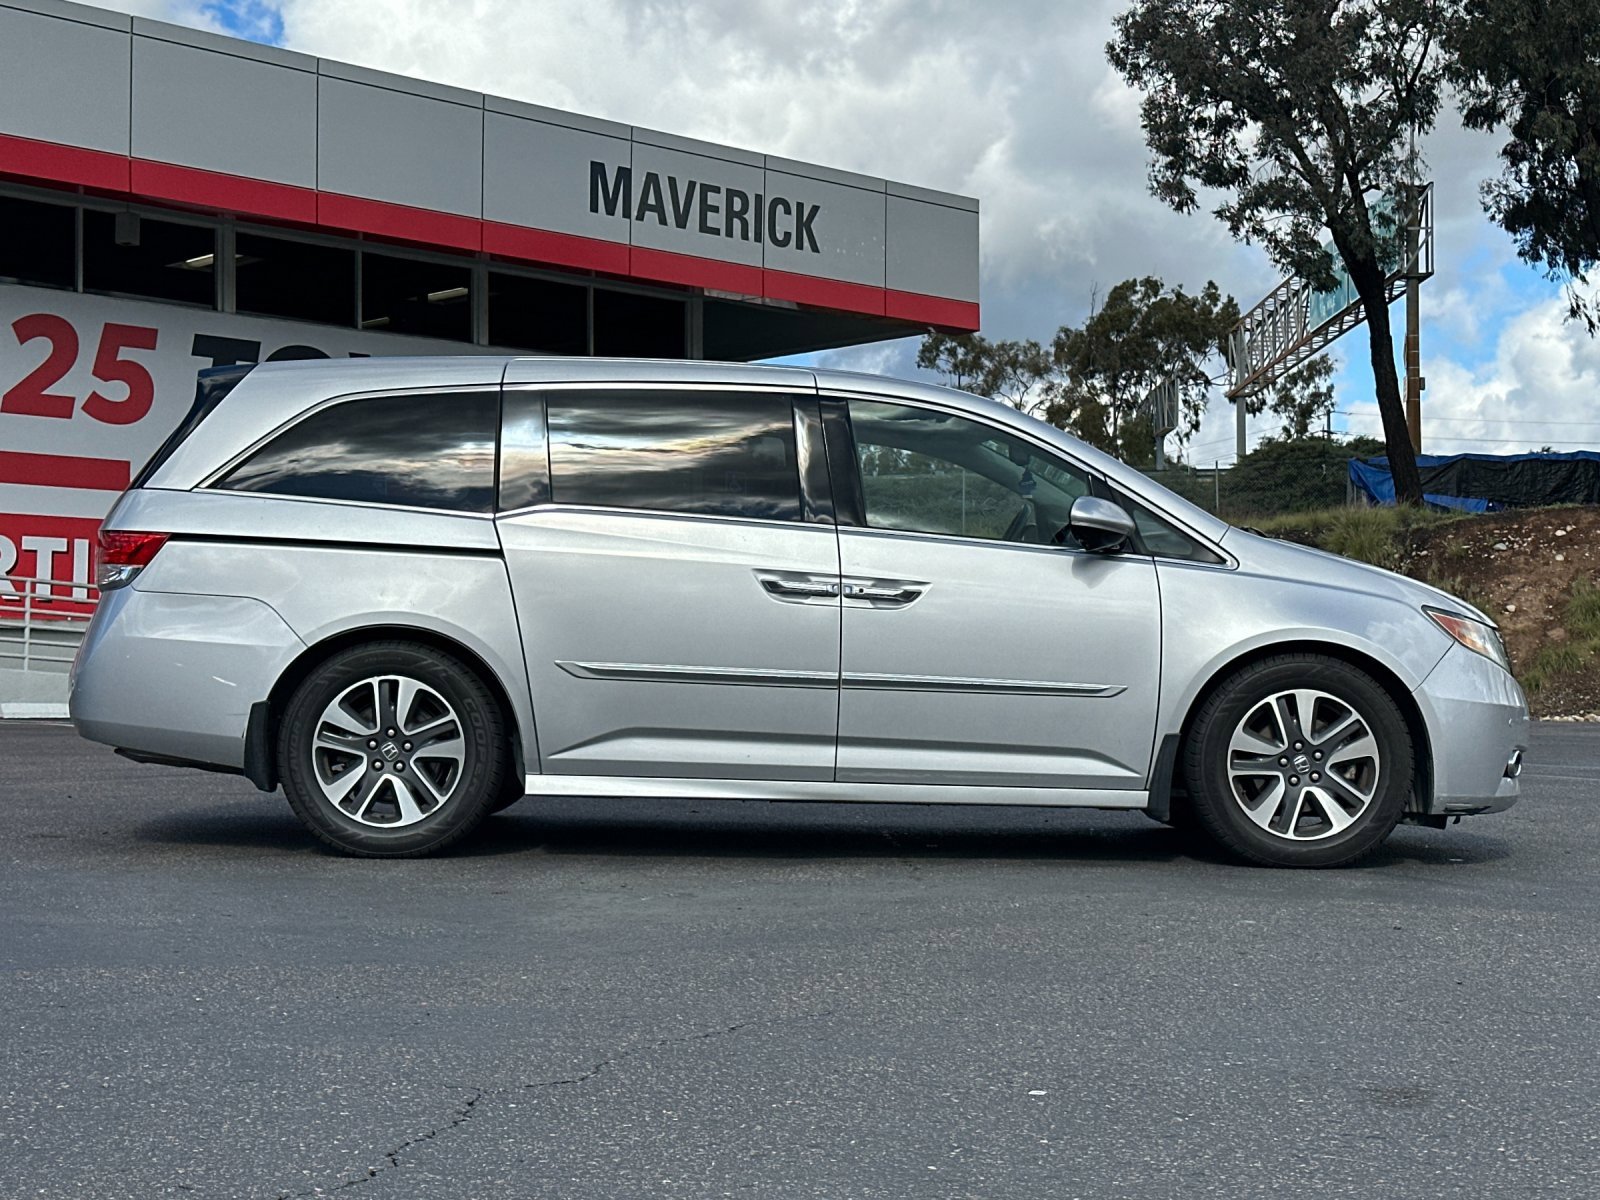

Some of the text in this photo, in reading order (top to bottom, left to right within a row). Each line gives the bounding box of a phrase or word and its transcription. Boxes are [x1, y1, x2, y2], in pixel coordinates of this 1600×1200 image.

[589, 160, 820, 253] MAVERICK
[0, 313, 158, 425] 25
[462, 697, 488, 794] COOPER
